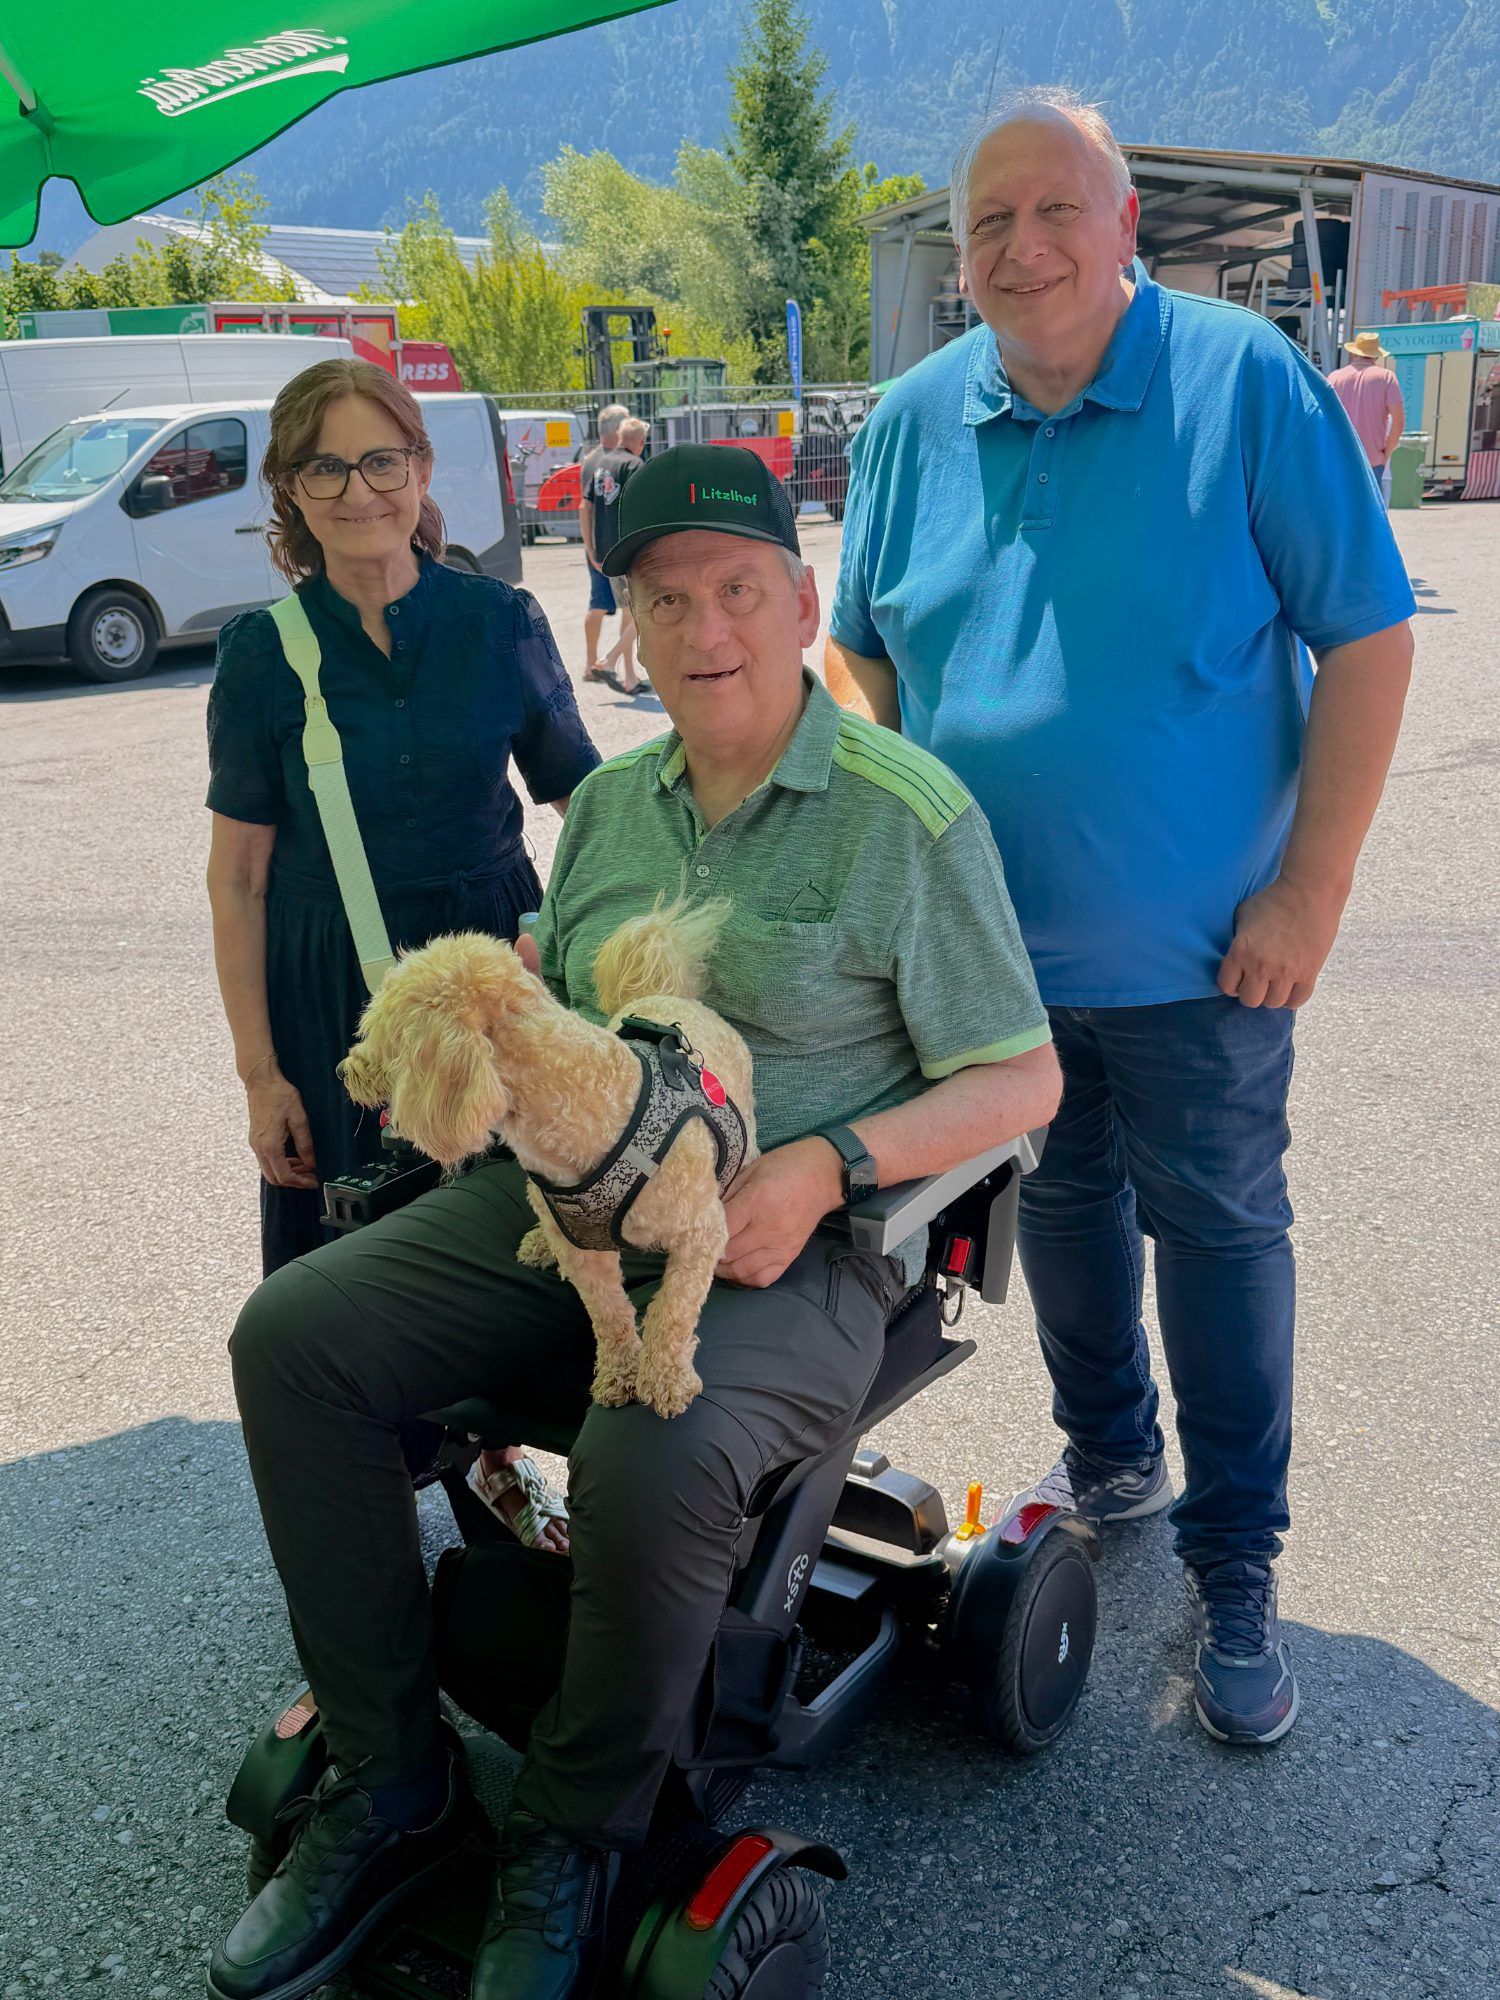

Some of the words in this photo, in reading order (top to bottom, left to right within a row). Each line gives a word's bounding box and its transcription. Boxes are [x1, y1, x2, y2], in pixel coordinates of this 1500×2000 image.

[1404, 333, 1457, 346] YOGURT
[702, 487, 757, 506] Litzlhof
[783, 1553, 809, 1613] xsto
